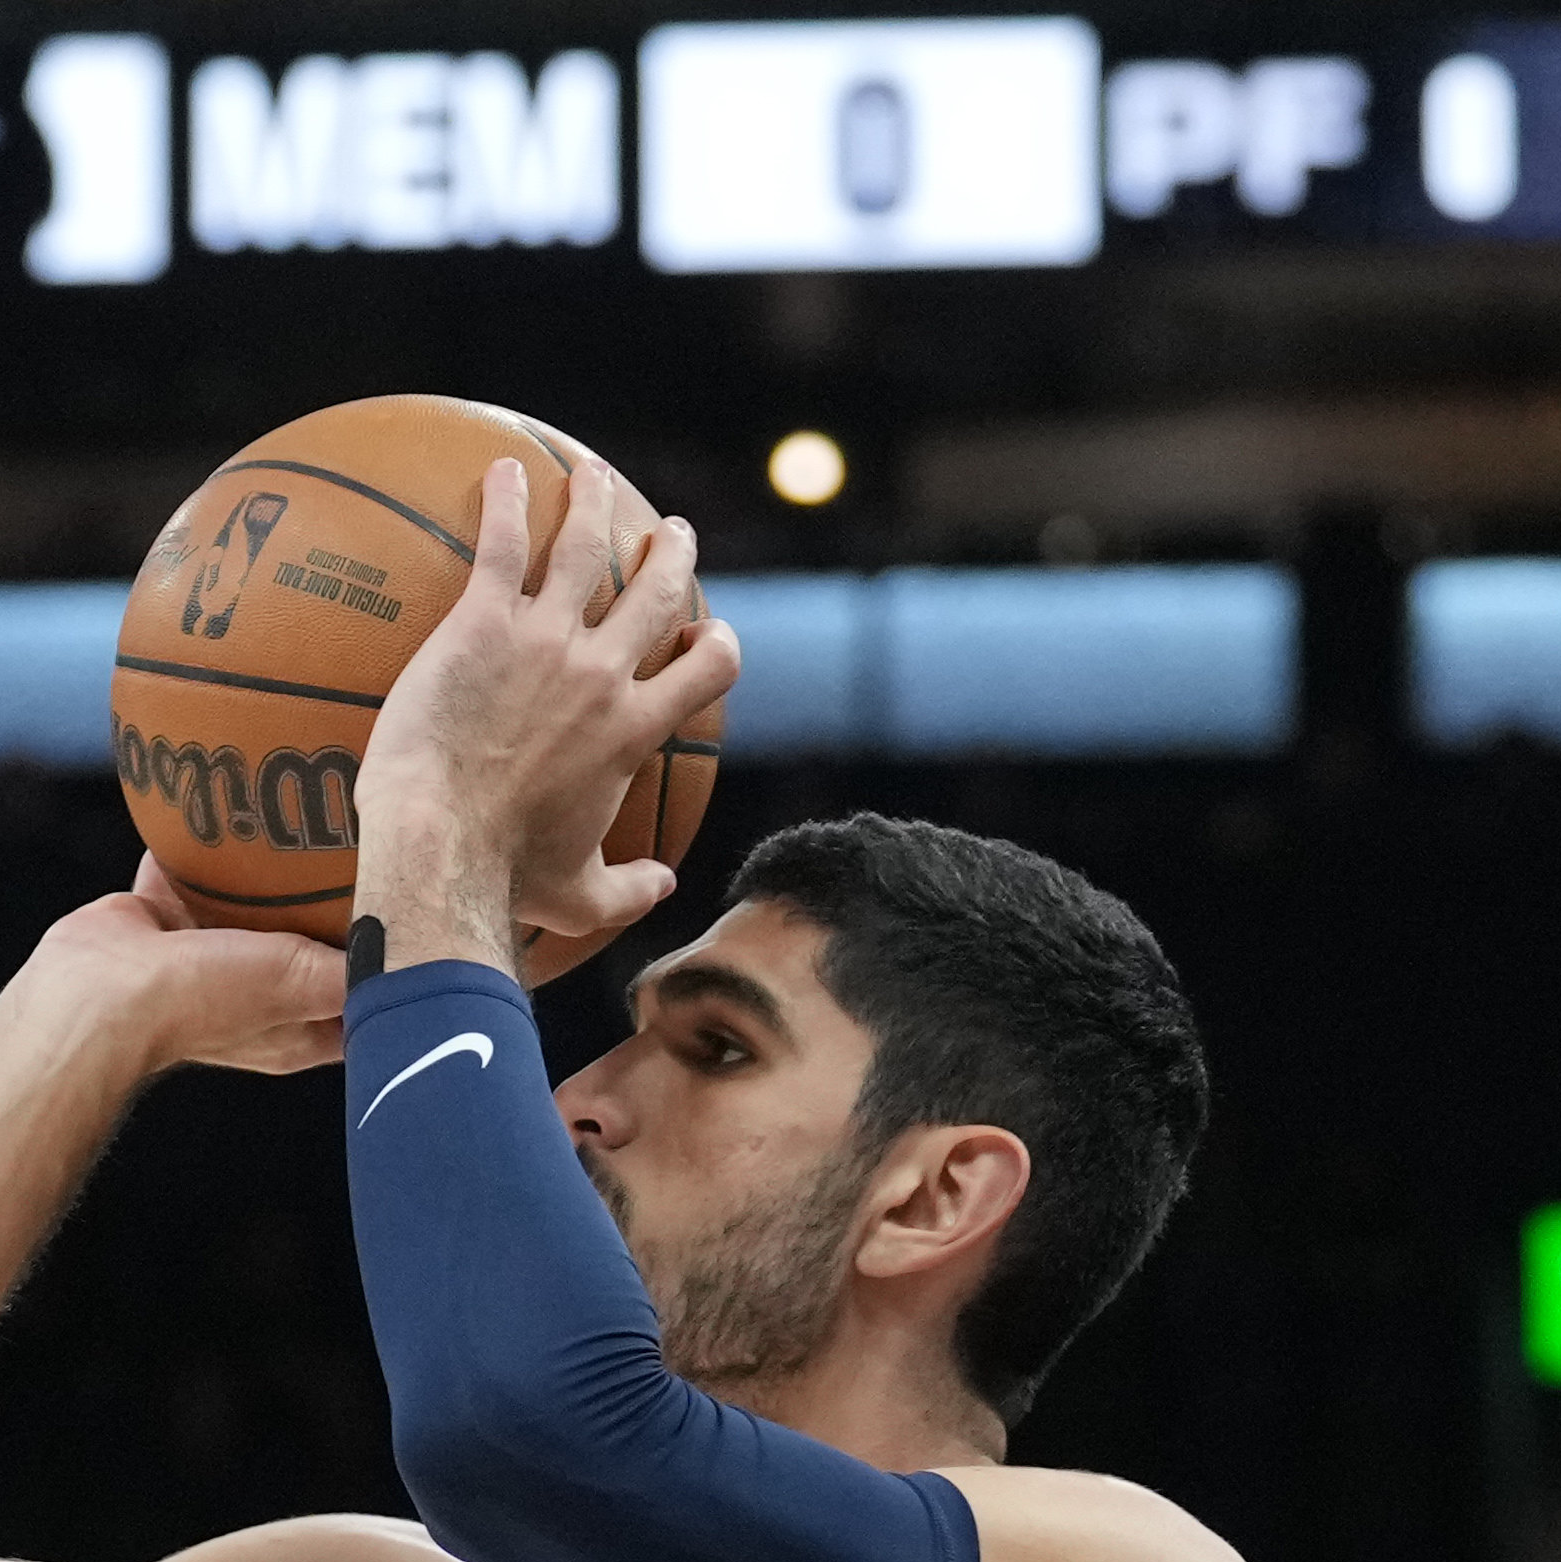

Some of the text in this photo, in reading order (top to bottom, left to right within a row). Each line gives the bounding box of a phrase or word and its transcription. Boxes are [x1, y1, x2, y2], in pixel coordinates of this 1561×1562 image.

[187, 52, 622, 252] MEM
[835, 76, 912, 218] 0
[1103, 58, 1370, 218] PF
[341, 582, 402, 622] OFFICIAL
